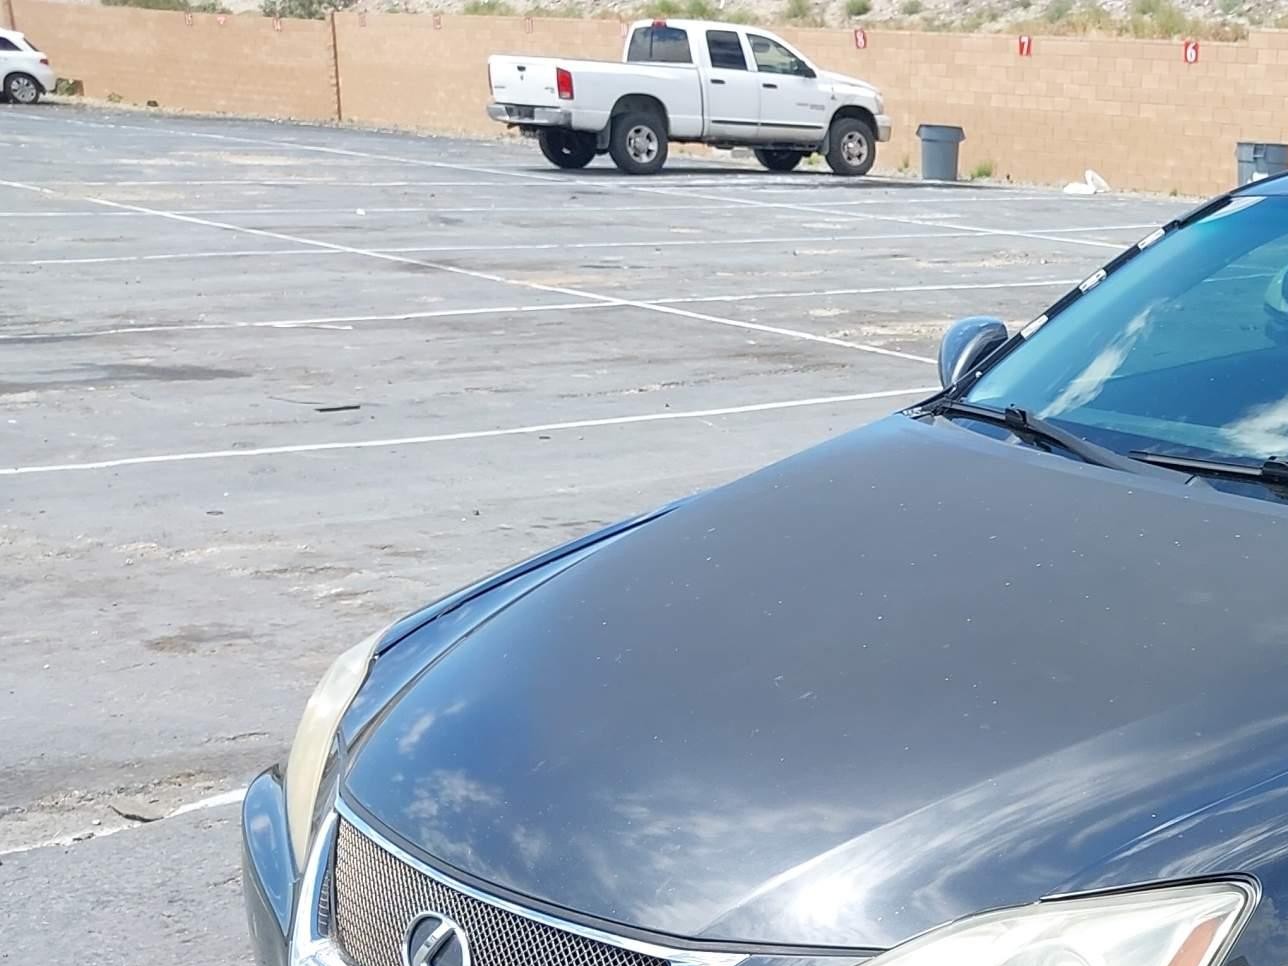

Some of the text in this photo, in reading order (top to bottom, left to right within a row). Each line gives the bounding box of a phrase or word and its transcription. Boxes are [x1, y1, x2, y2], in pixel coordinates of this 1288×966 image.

[856, 31, 866, 48] 8
[1020, 36, 1030, 56] 7
[1186, 42, 1197, 63] 6
